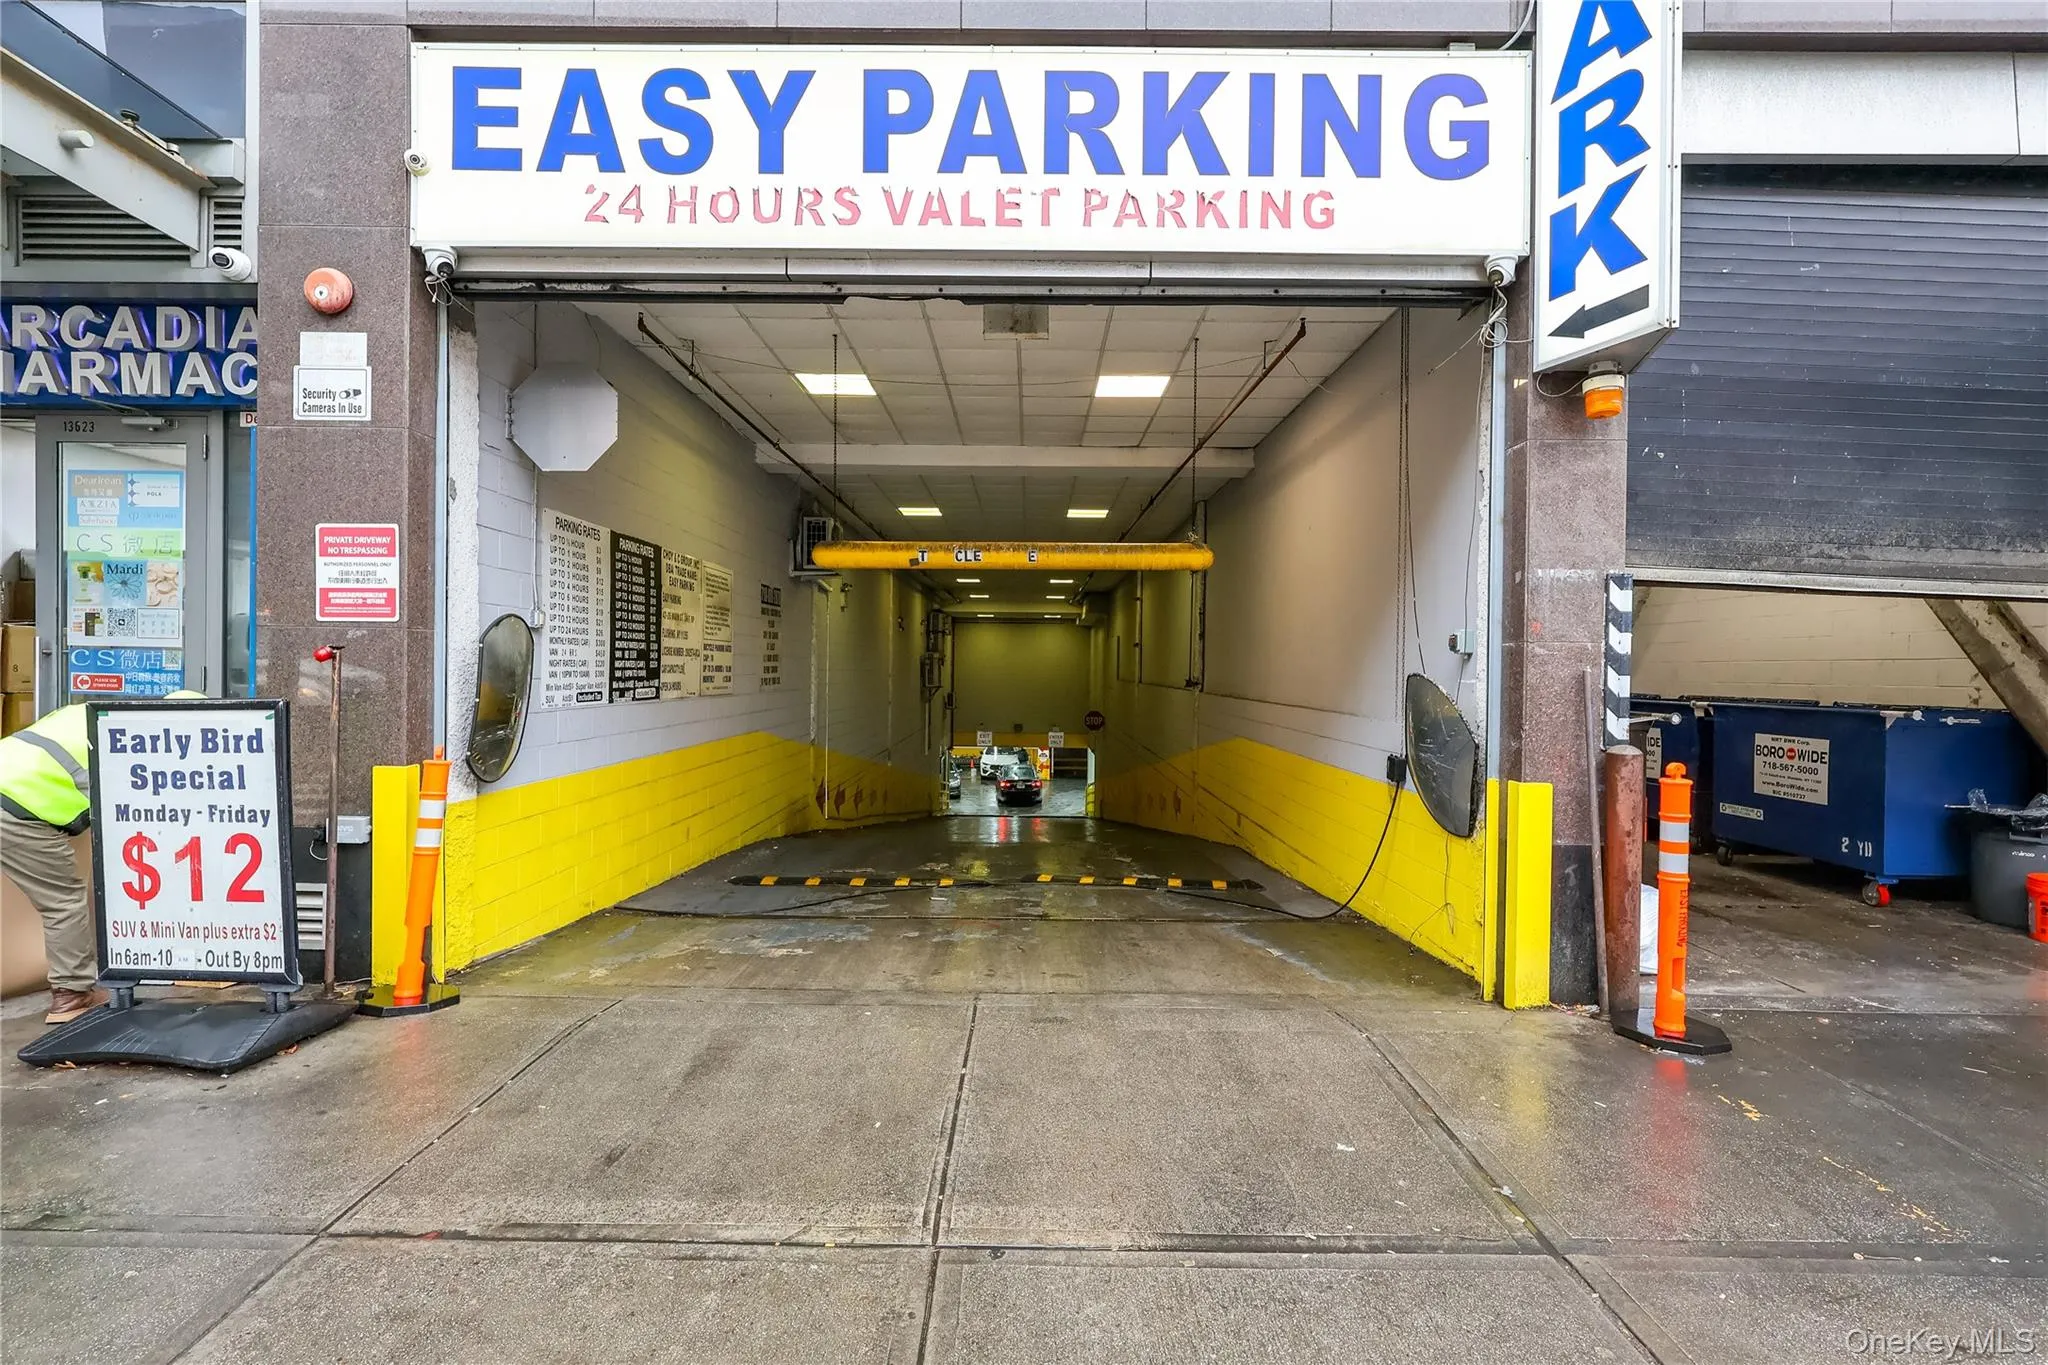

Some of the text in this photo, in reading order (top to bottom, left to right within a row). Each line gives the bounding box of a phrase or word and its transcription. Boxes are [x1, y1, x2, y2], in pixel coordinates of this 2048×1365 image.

[452, 65, 1490, 181] EASY PARKING
[584, 184, 1336, 230] 24 HOURS VALET PARKING
[0, 304, 258, 350] RCADIA
[302, 387, 337, 402] Security
[302, 402, 362, 414] Cameras In Use
[63, 420, 95, 433] 13623
[555, 516, 601, 542] PARKING RATES
[323, 536, 391, 544] PRIVATE DRIVEWAY
[550, 533, 558, 542] UP
[558, 535, 565, 545] TO
[571, 540, 585, 550] HOUR
[327, 546, 388, 555] NO TRESPASSING
[550, 545, 558, 554] UP
[558, 546, 565, 556] TO
[572, 551, 587, 561] HOUR
[619, 537, 654, 559] PARKING RATES
[918, 545, 1036, 562] T CLE E
[106, 564, 144, 575] Mardi
[550, 557, 558, 566] UP
[558, 558, 565, 568] TO
[572, 562, 589, 573] HOURS
[550, 568, 558, 577] UP
[558, 569, 565, 579] TO
[572, 573, 589, 583] HOURS
[550, 580, 558, 589] UP
[558, 580, 565, 590] TO
[572, 584, 589, 594] HOURS
[669, 576, 695, 592] EASY PARKING
[550, 591, 558, 600] UP
[558, 592, 565, 601] TO
[572, 595, 589, 605] HOURS
[550, 602, 558, 611] UP
[558, 603, 565, 612] TO
[572, 606, 589, 615] HOURS
[550, 613, 558, 622] UP
[558, 614, 565, 623] TO
[572, 616, 589, 626] HOURS
[550, 625, 558, 634] UP
[558, 625, 565, 634] TO
[572, 627, 589, 636] HOURS
[549, 648, 558, 657] VAN
[12, 664, 19, 673] 8
[549, 659, 562, 668] NIGHT
[549, 670, 558, 679] VAN
[545, 695, 555, 704] SUV
[1085, 716, 1103, 726] STOP
[108, 728, 264, 760] Early Bird
[1755, 744, 1828, 765] BORO WIDE
[1762, 761, 1819, 776] 718-567-5000
[130, 763, 247, 796] Special
[115, 803, 191, 827] Monday
[207, 804, 271, 828] Friday
[1841, 836, 1850, 853] 2
[121, 831, 265, 911] $12
[112, 920, 277, 943] SUV & Mini Van plus extra $2
[110, 948, 122, 965] In
[205, 950, 230, 968] Out
[233, 950, 250, 972] By
[254, 951, 283, 972] 8pm
